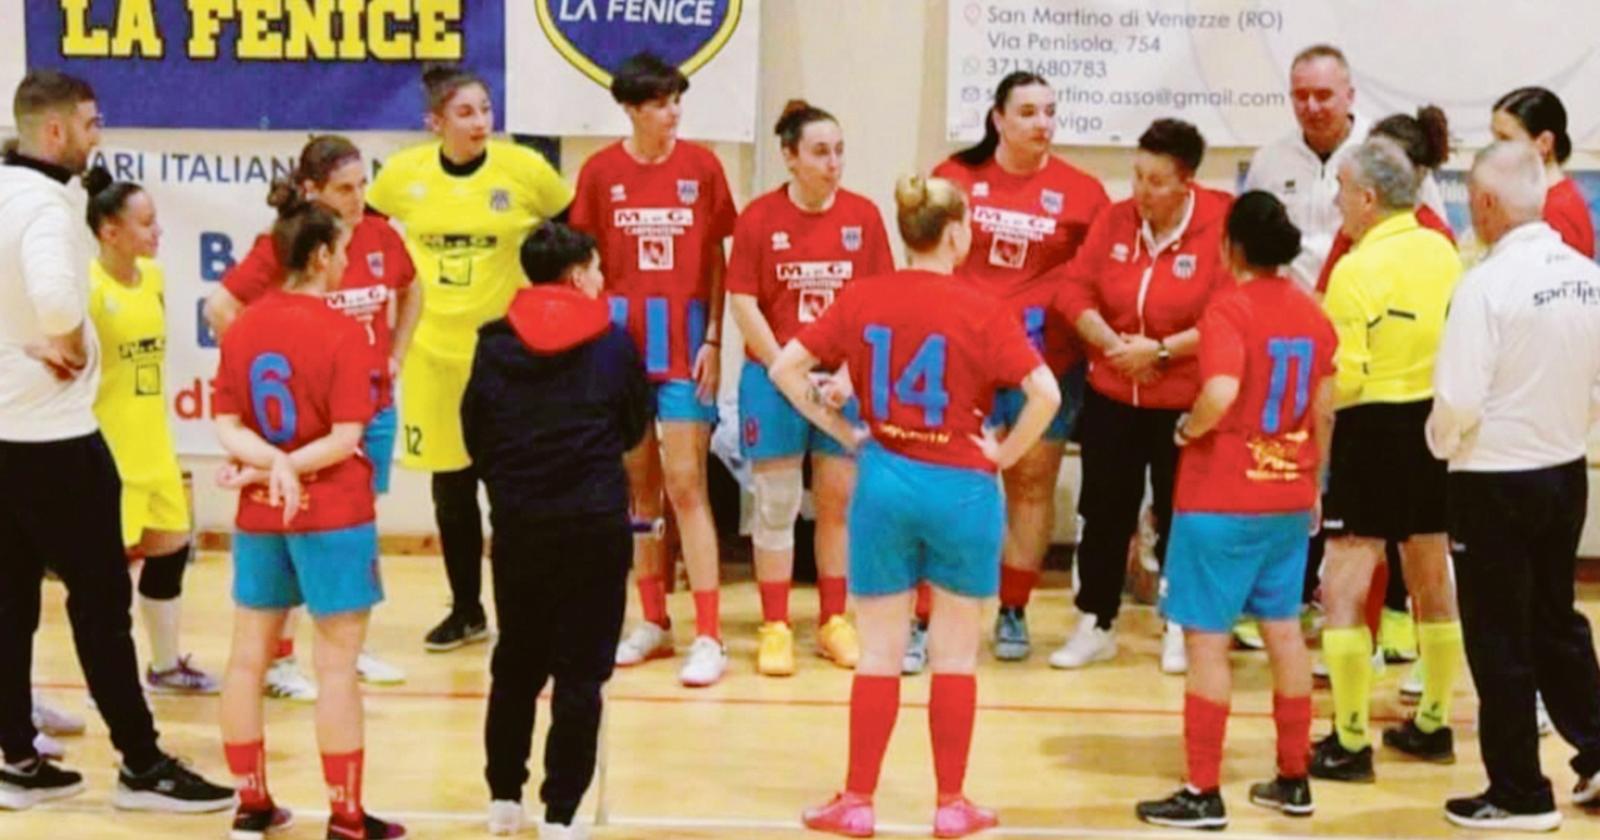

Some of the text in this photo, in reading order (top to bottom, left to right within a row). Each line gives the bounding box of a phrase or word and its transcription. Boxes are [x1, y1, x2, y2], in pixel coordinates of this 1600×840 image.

[558, 0, 715, 27] LA FENICE
[987, 5, 1284, 31] San Martino di Venezze (RO)
[62, 0, 463, 60] LA FENICE
[987, 32, 1161, 54] Via Penisola, 754
[986, 57, 1107, 78] 3713680783
[863, 323, 951, 428] 14
[249, 351, 297, 445] 6
[404, 424, 423, 457] 12
